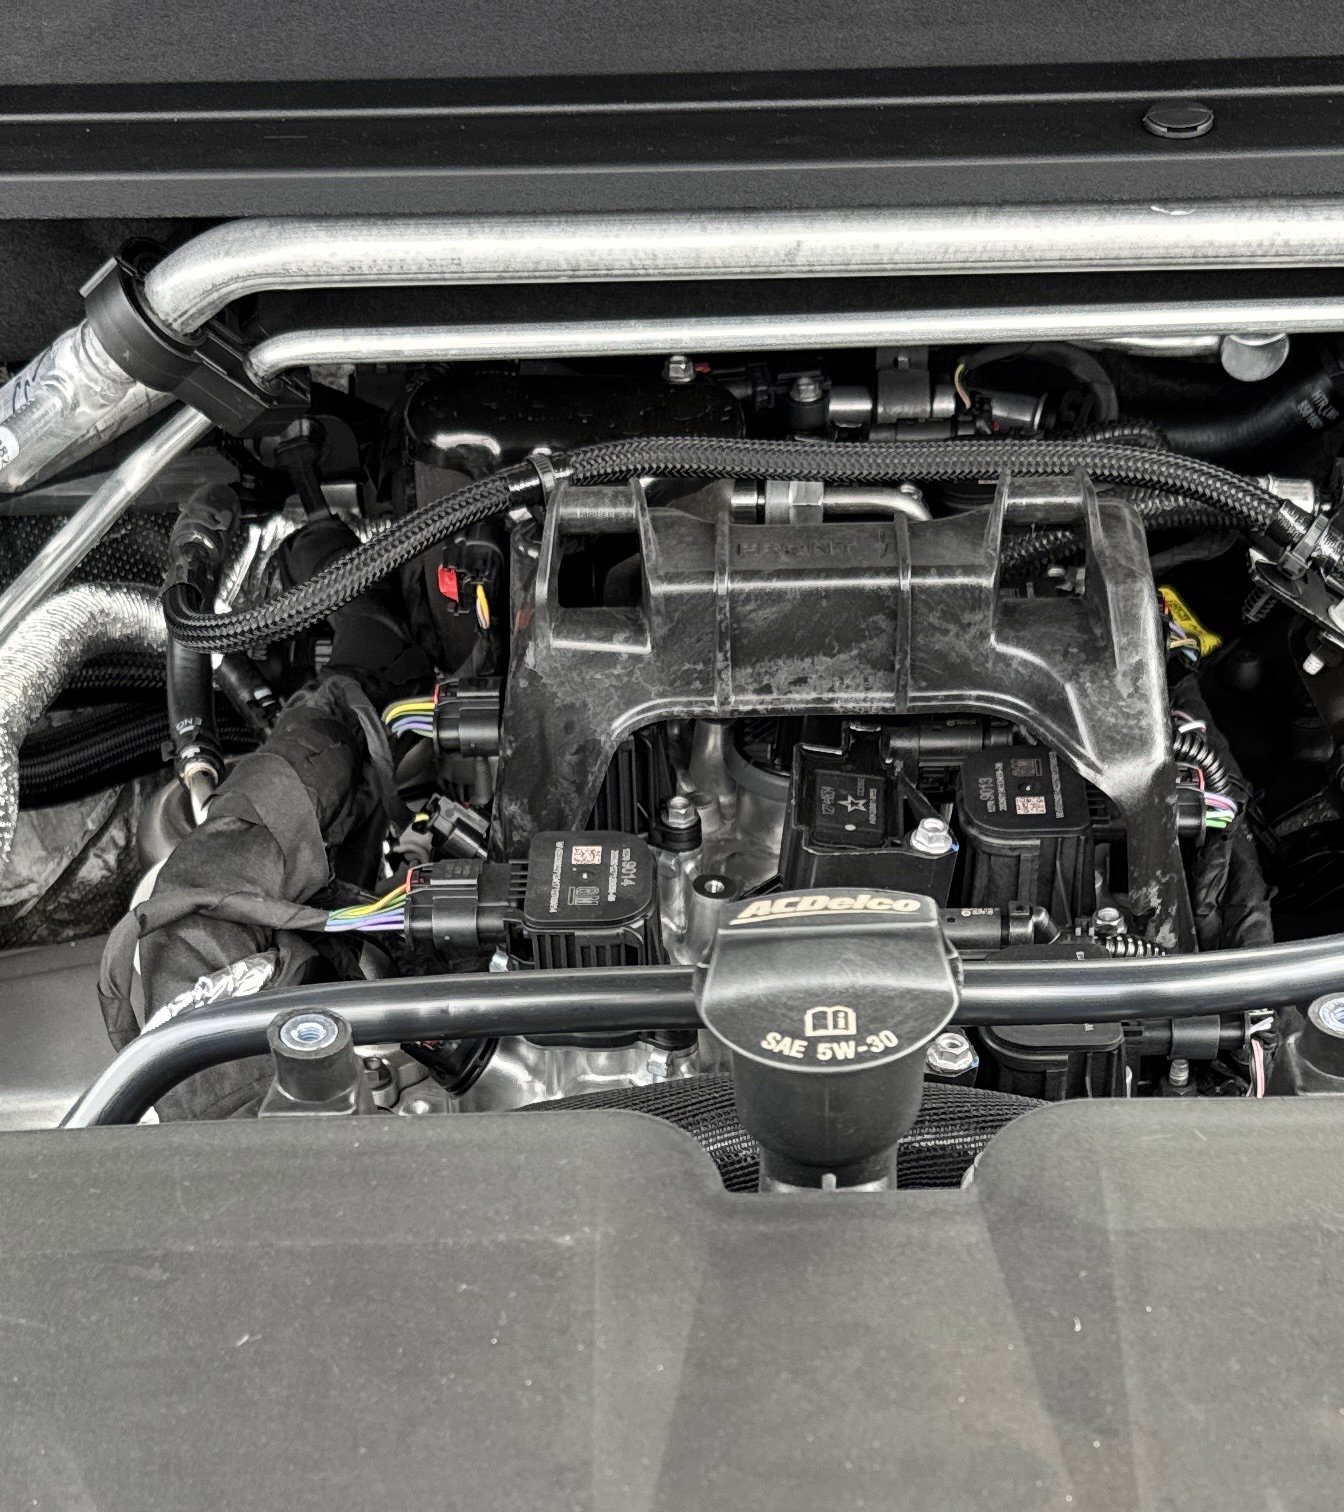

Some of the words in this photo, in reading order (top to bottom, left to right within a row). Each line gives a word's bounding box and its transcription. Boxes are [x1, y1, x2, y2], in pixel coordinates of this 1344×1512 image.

[621, 861, 637, 887] 9014
[736, 894, 921, 919] ACDelco
[760, 1032, 809, 1058] SAE
[815, 1030, 899, 1061] 5W-30
